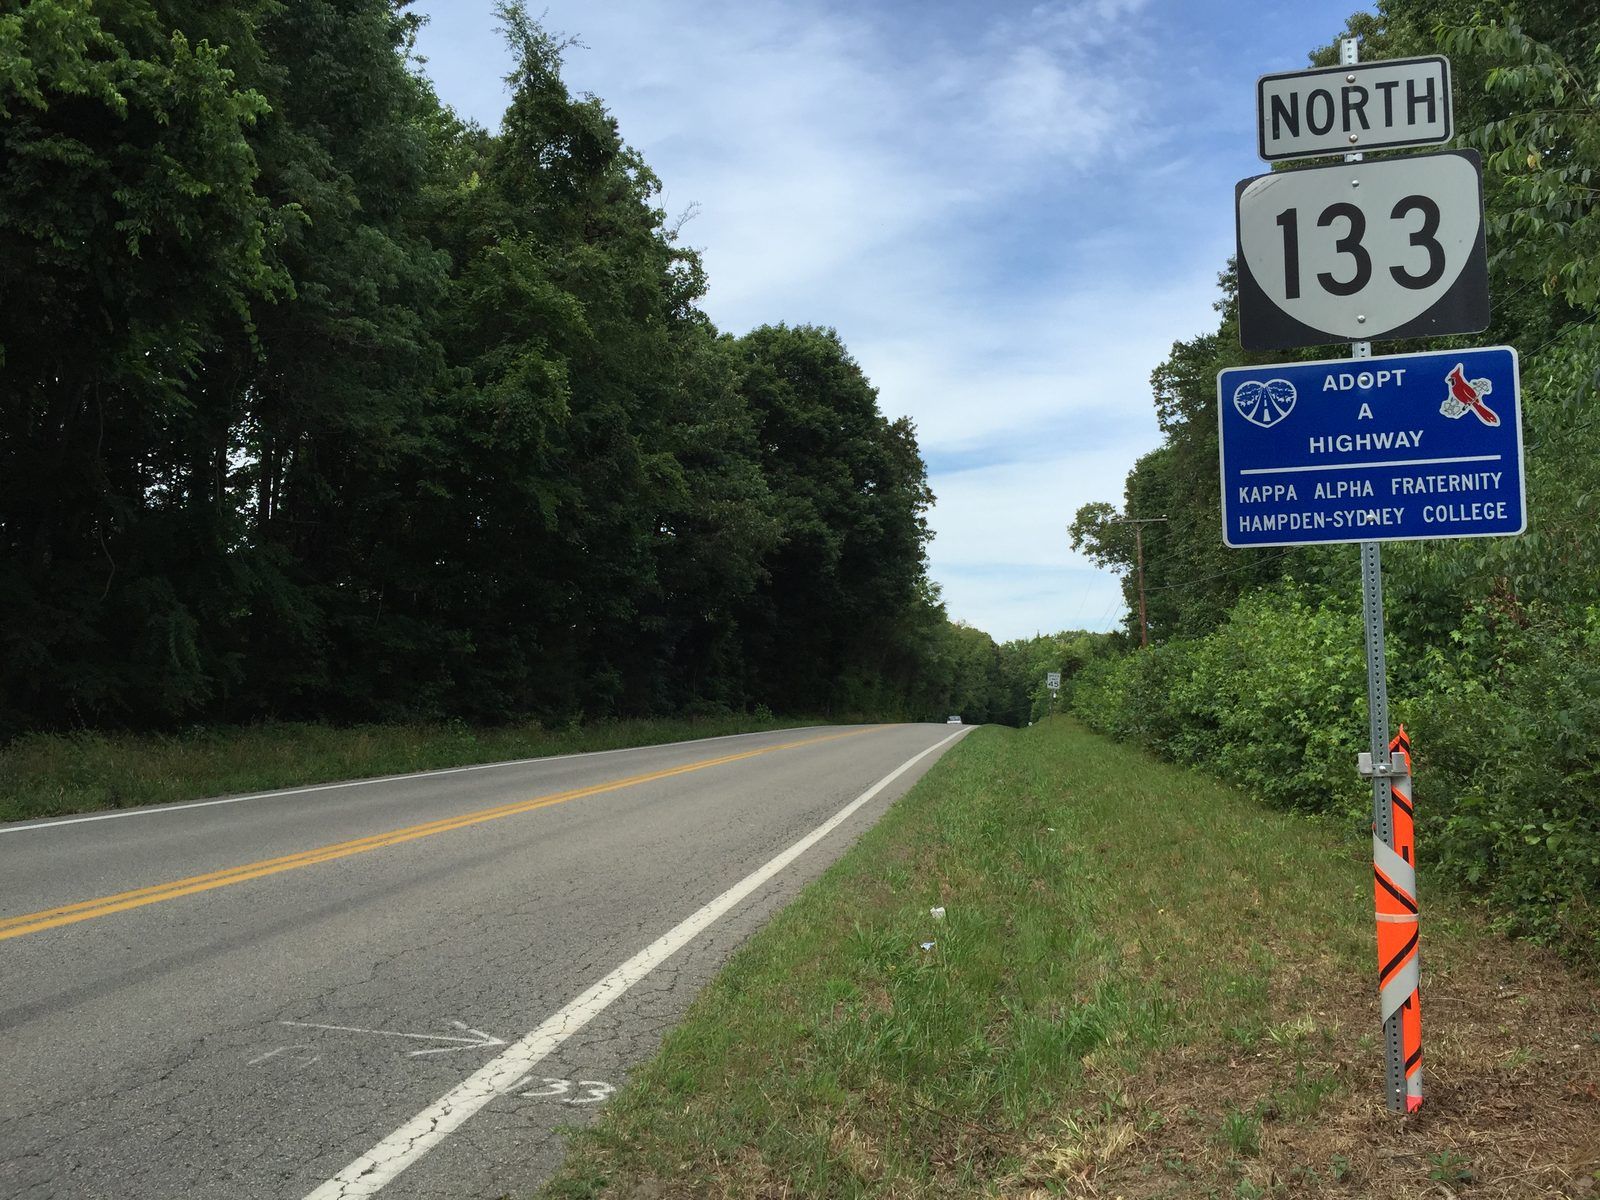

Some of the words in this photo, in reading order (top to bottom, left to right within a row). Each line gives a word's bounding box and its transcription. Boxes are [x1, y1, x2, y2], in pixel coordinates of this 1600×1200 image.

[1271, 77, 1436, 140] NORTH
[1276, 195, 1446, 299] 133
[1322, 369, 1406, 392] ADOPT
[1357, 403, 1374, 419] A
[1309, 430, 1424, 453] HIGHWAY
[1239, 484, 1297, 503] KAPPA
[1314, 480, 1374, 499] ALPHA
[1391, 472, 1502, 495] FRATERNITY
[1239, 508, 1404, 532] HAMPDEN-SYDNEY
[1423, 502, 1508, 523] COLLEGE
